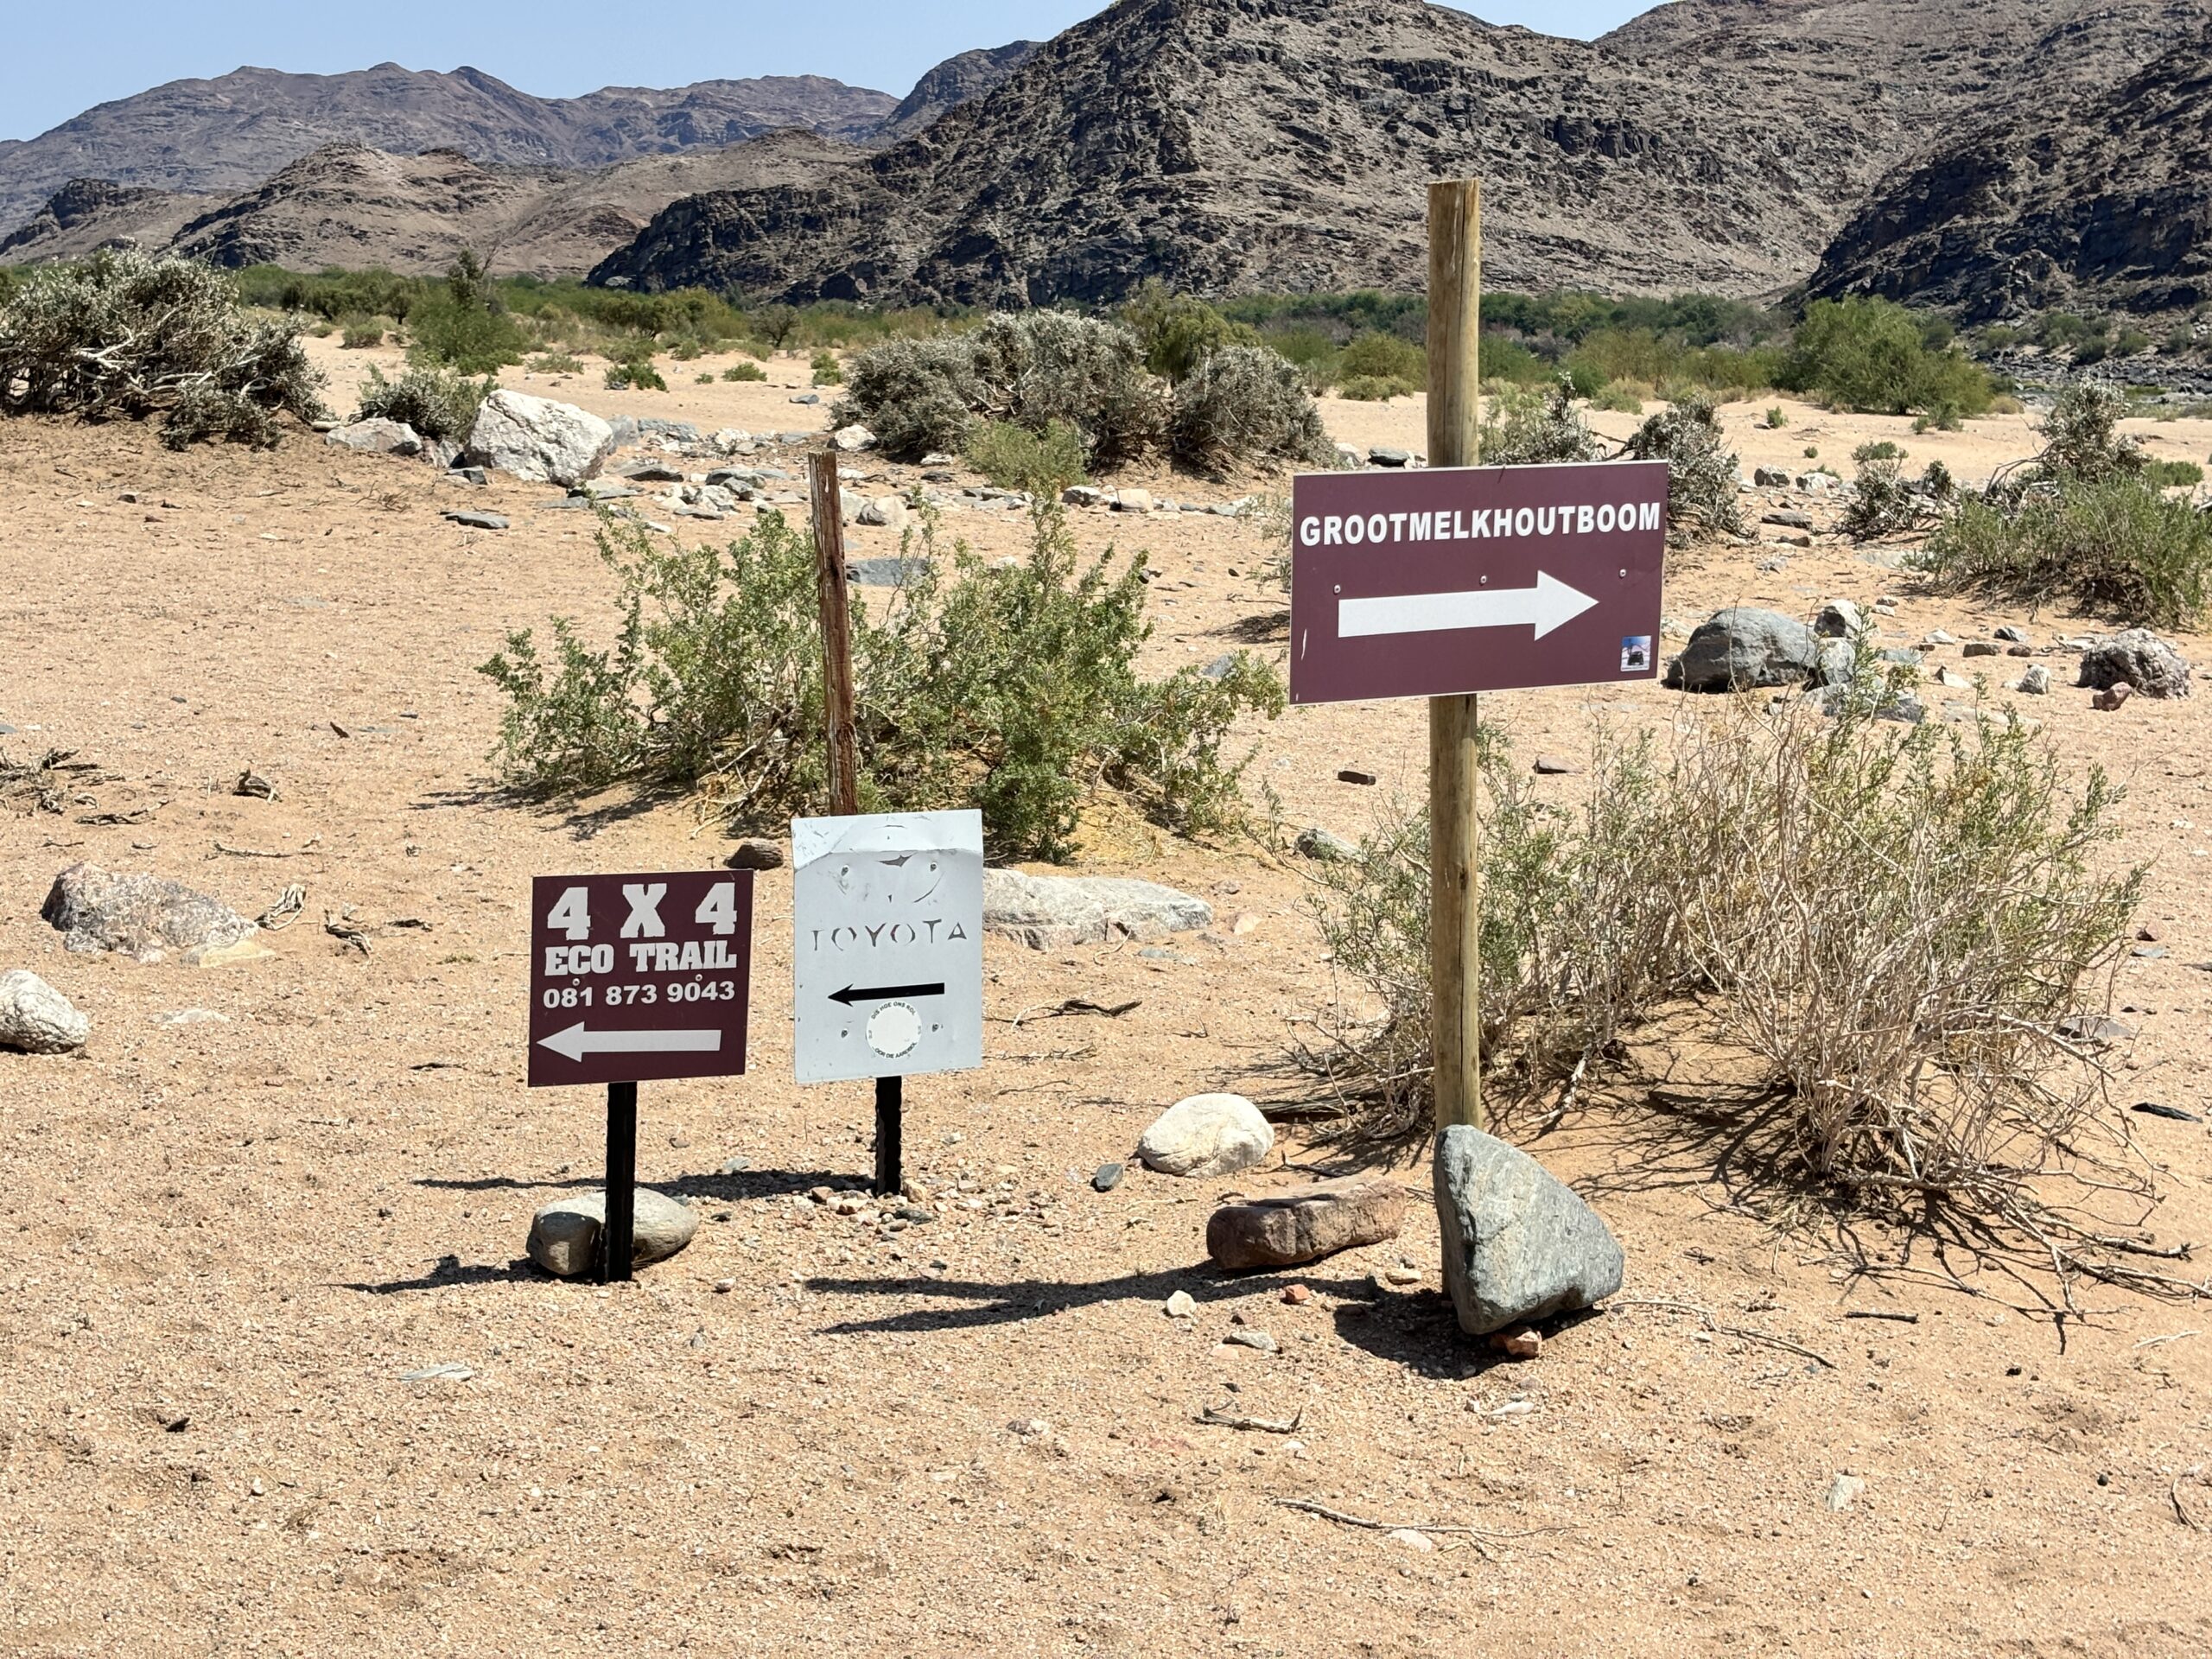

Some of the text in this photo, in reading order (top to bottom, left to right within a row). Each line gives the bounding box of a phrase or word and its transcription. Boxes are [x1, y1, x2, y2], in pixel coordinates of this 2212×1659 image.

[1300, 502, 1660, 546] GROOTMELKHOUTBOOM
[547, 882, 737, 940] 4 X 4
[810, 918, 967, 951] TOYOTA
[544, 940, 737, 976] ECO TRAIL
[543, 981, 735, 1008] 081 873 9043
